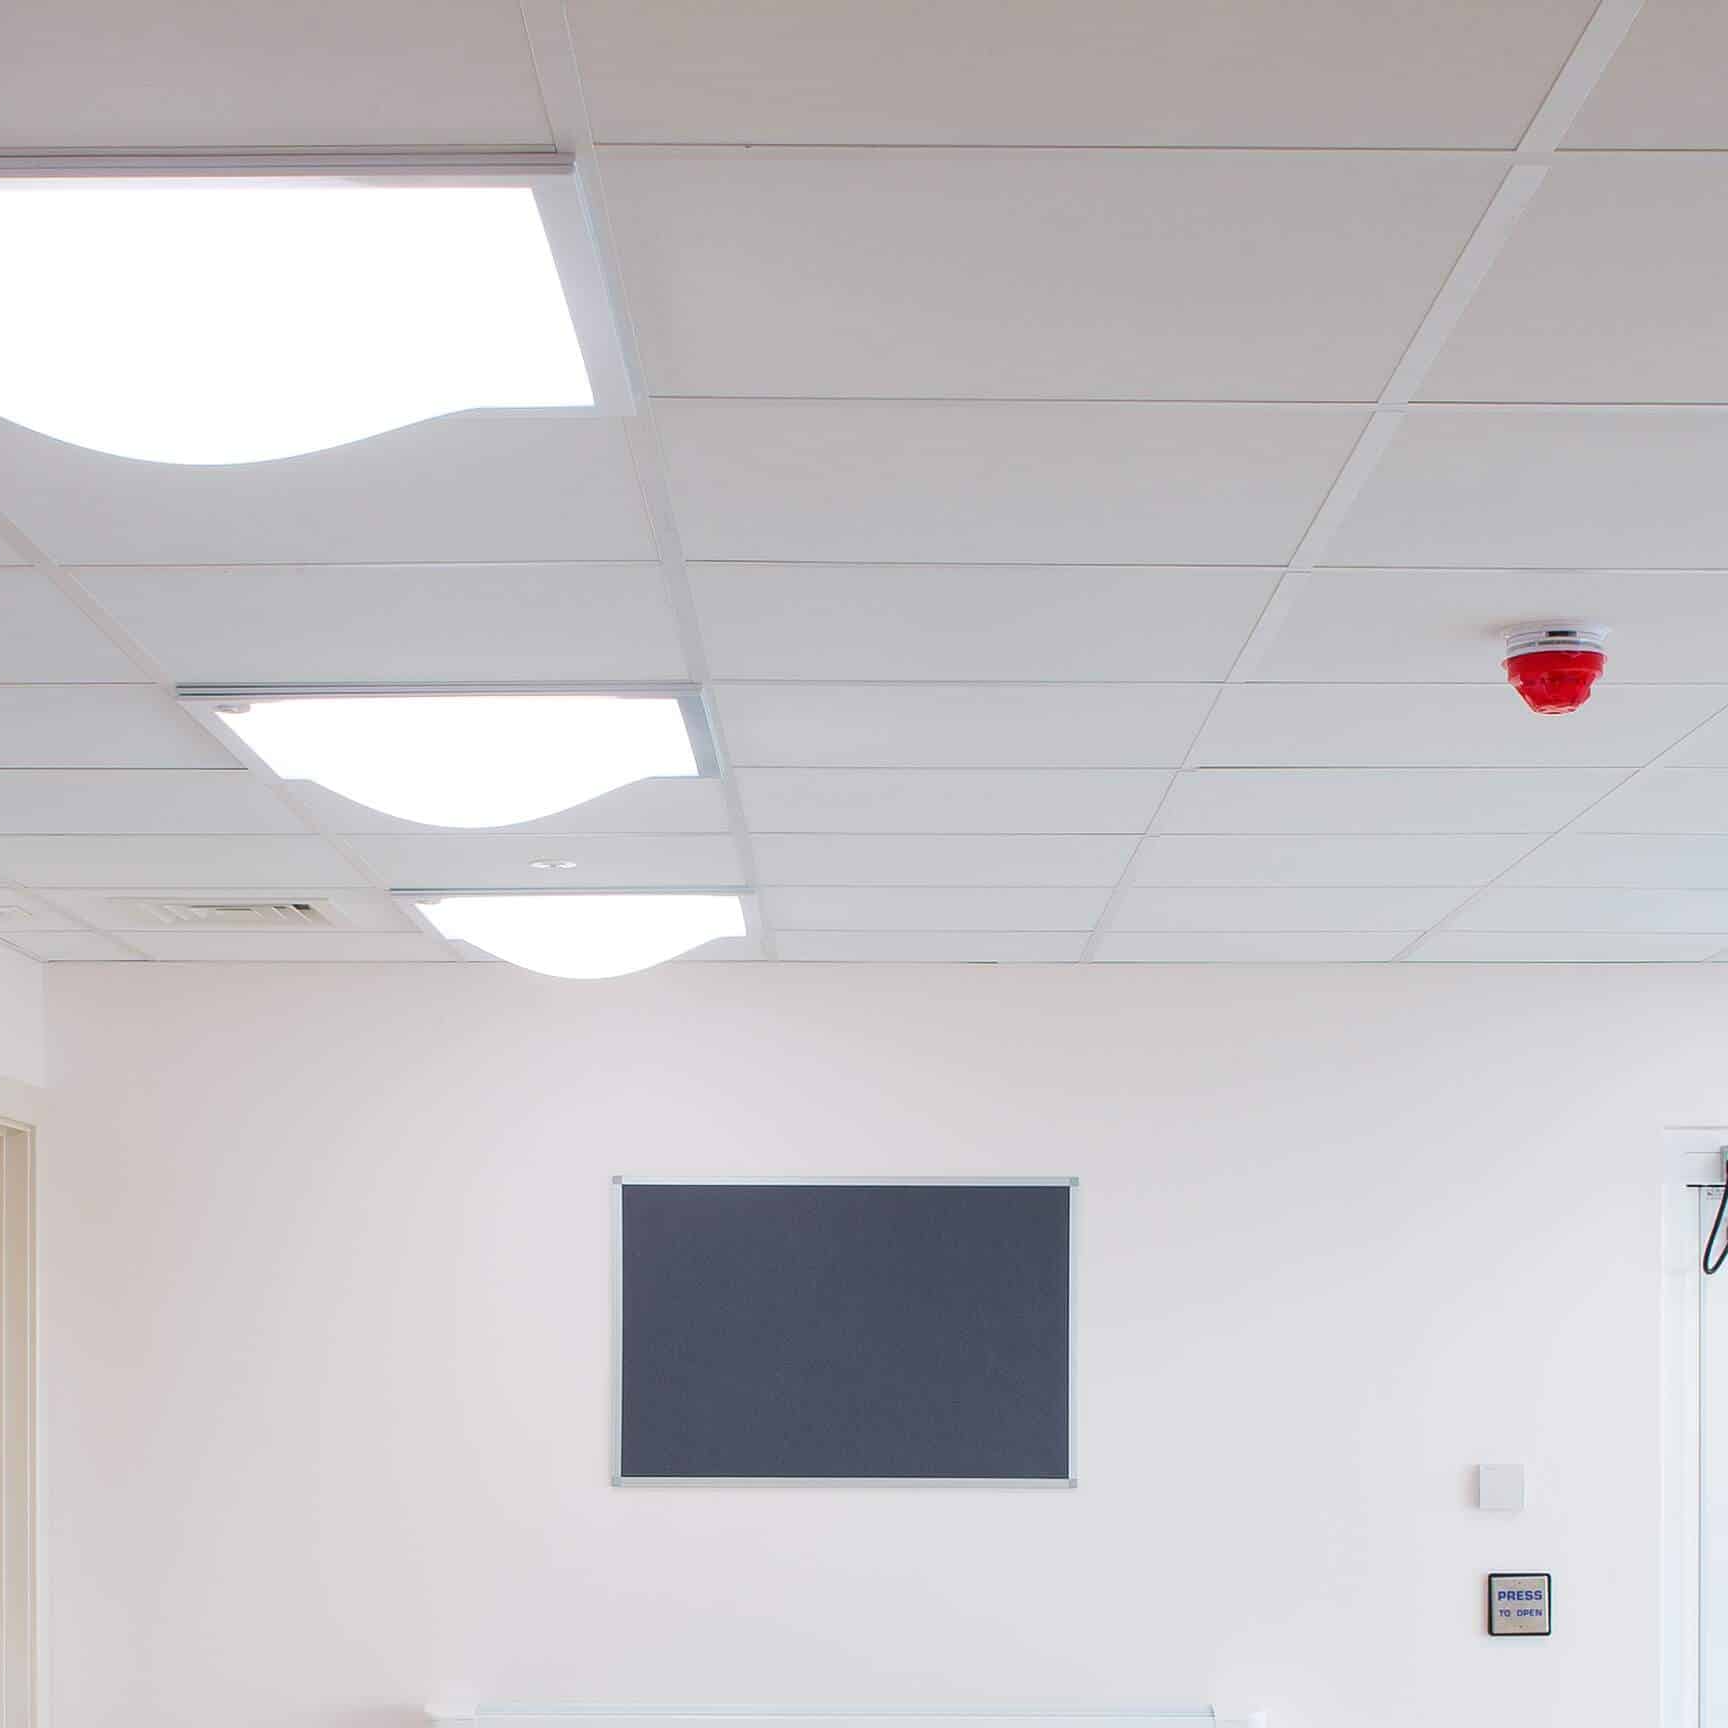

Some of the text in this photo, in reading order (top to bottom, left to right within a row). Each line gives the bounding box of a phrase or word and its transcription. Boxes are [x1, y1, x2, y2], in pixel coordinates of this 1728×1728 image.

[1497, 1590, 1543, 1601] PRESS
[1499, 1608, 1543, 1618] TO OPEN
